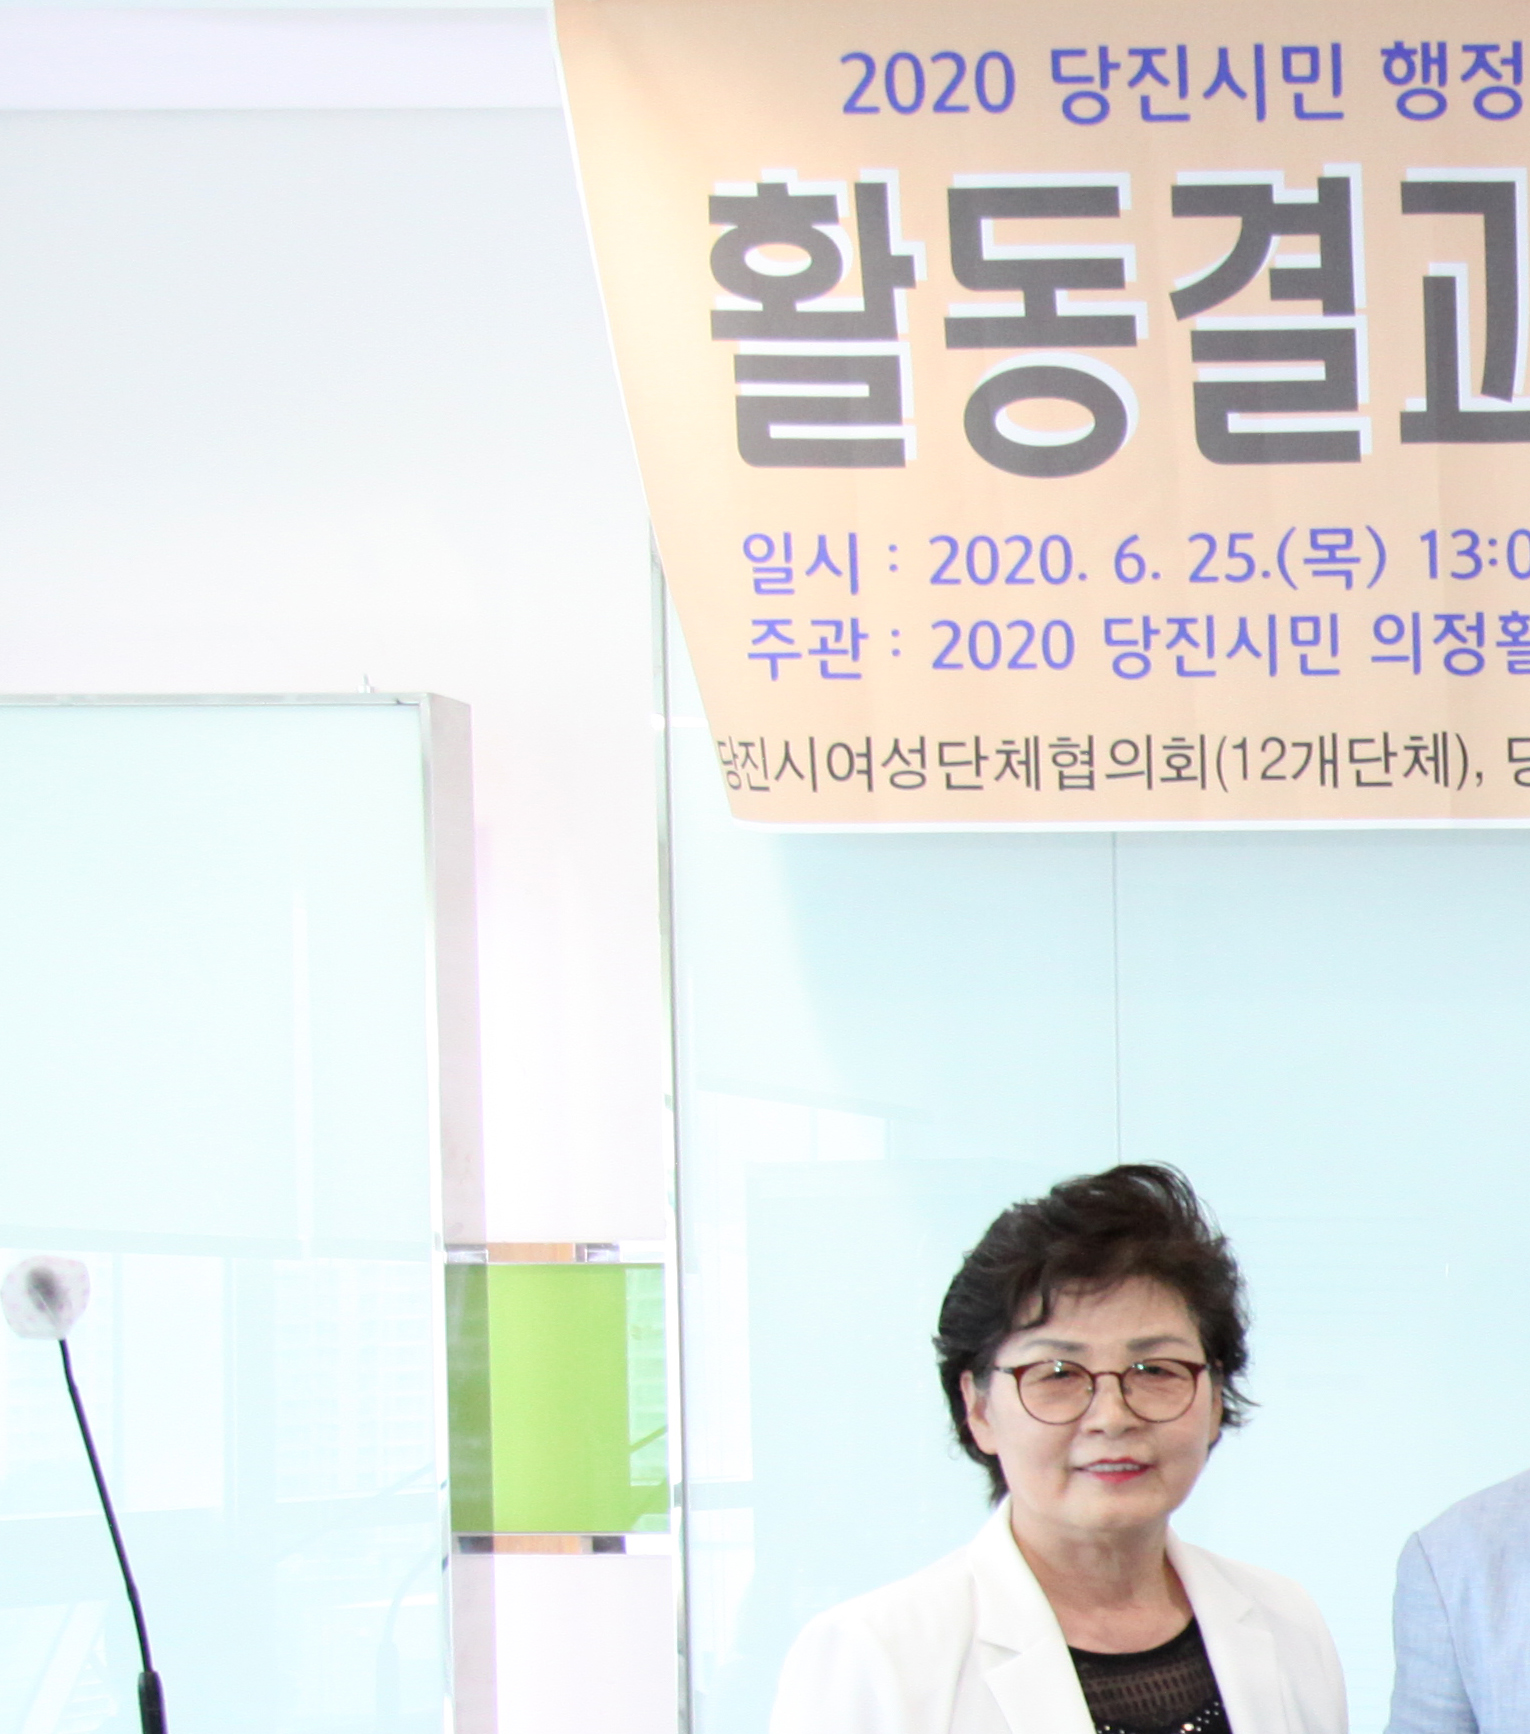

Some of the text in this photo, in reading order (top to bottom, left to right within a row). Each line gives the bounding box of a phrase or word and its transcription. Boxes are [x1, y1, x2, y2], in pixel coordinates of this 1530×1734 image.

[840, 49, 1015, 115] 2020
[1050, 40, 1345, 126] 당진시민
[930, 534, 1086, 585] 2020.
[1114, 534, 1160, 584] 6.
[1189, 525, 1386, 590] 25.(목)
[932, 620, 1074, 670] 2020
[1104, 613, 1340, 679] 당진시민
[718, 731, 1483, 792] 당진시여성단체협의회(12개단체),
